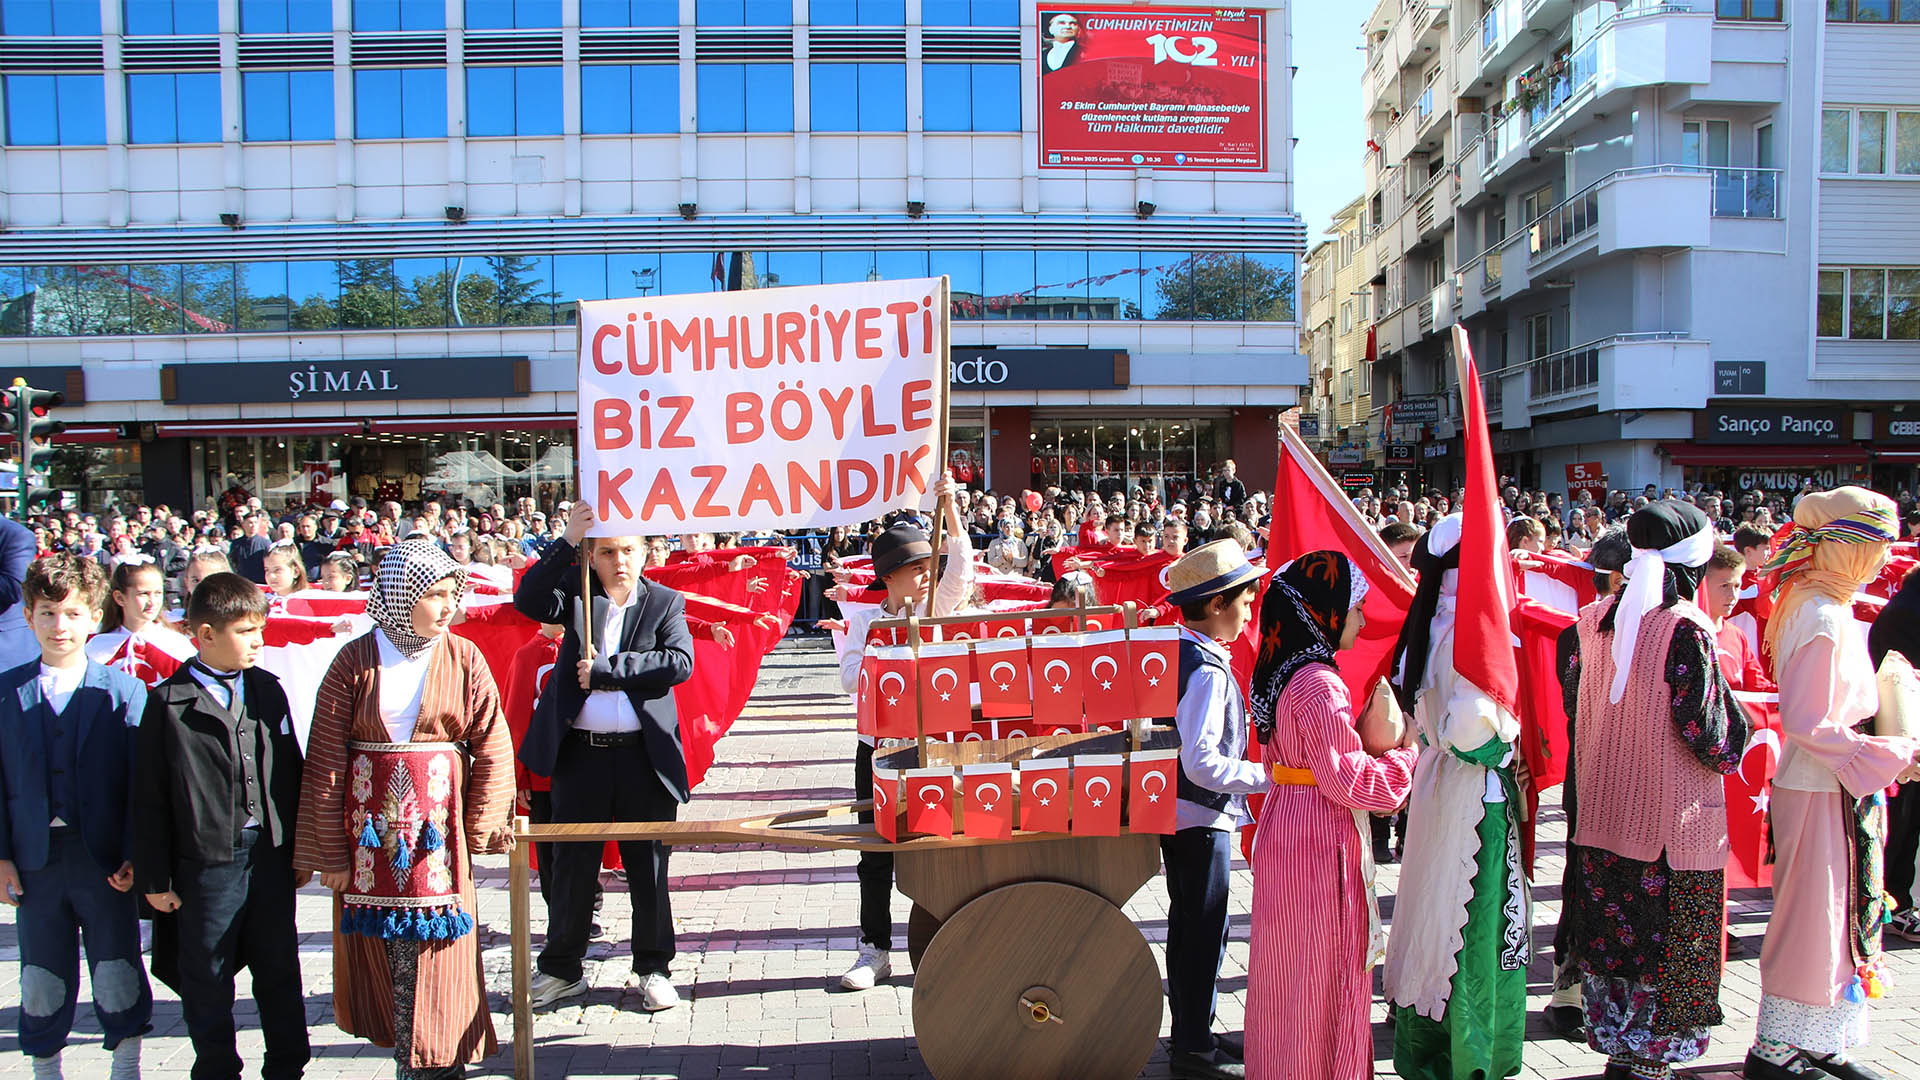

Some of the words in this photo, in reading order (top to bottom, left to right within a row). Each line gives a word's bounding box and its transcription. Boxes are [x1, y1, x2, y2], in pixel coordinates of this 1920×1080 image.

[1086, 18, 1214, 32] CUMHURİYETİMİZİN
[1231, 56, 1255, 67] YILI
[1060, 102, 1073, 110] 29
[1074, 102, 1096, 110] Ekim
[1097, 102, 1148, 111] Cumhuriyet
[1149, 103, 1186, 112] Bayramı
[1187, 104, 1250, 113] münasebetiyle
[1081, 113, 1141, 122] düzenlenecek
[1143, 114, 1178, 122] kutlama
[1179, 115, 1230, 123] programına
[1087, 122, 1112, 132] Tüm
[1114, 123, 1164, 133] Halkımız
[1167, 124, 1224, 134] davetlidir.
[592, 295, 933, 376] CÜMHURİYETİ
[289, 364, 399, 399] ŞİMAL
[593, 389, 696, 450] BİZ
[725, 380, 932, 445] BÖYLE
[1718, 415, 1770, 436] Sanço
[1781, 415, 1834, 436] Panço
[1574, 465, 1591, 479] 5.
[598, 445, 931, 522] KAZANDIK
[787, 554, 822, 566] OLİS
